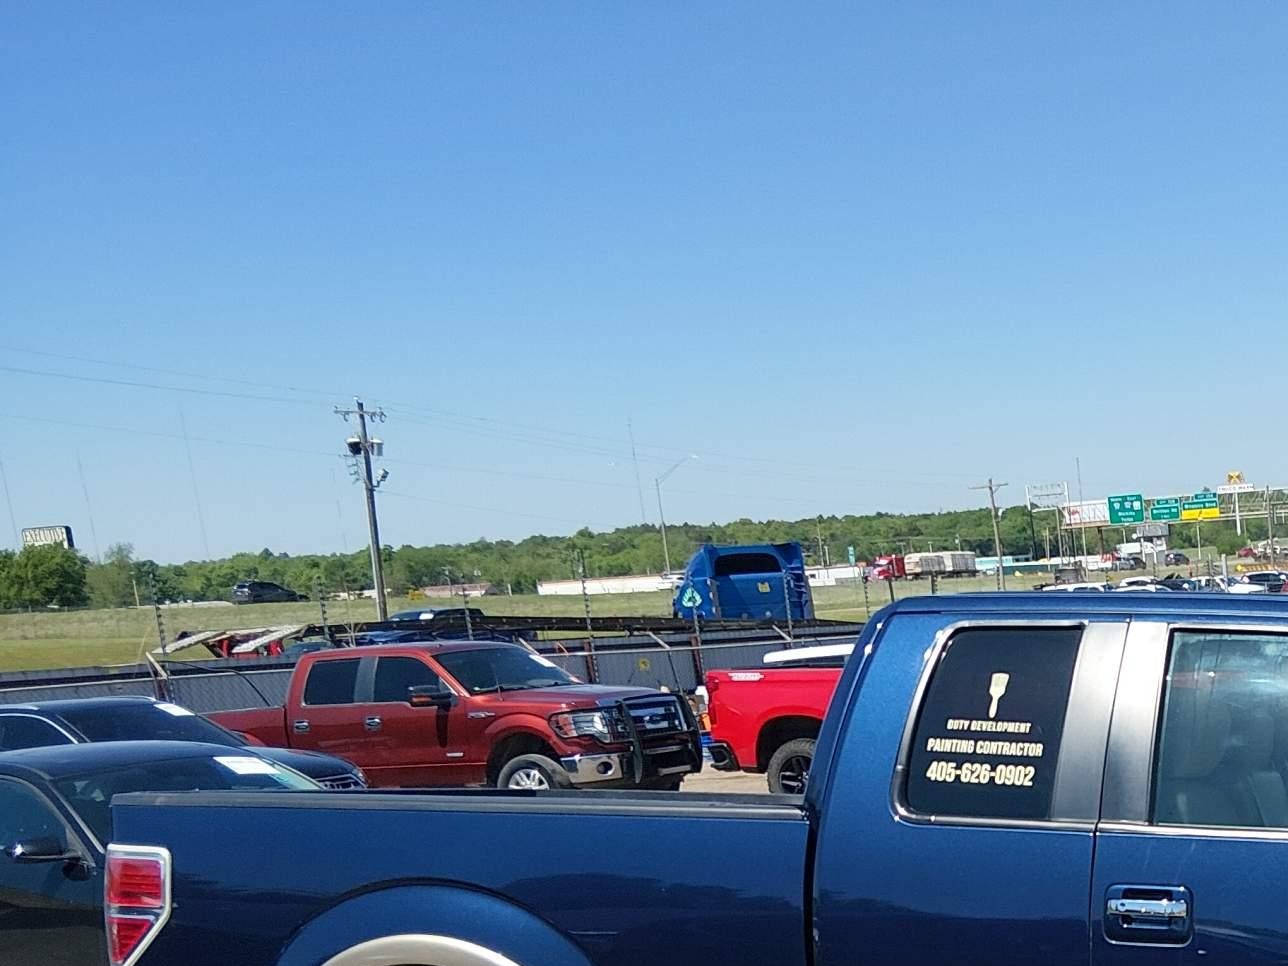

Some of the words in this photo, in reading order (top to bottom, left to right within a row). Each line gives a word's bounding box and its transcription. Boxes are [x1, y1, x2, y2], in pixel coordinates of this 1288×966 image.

[970, 720, 1031, 734] DEVELOPMENT
[927, 738, 974, 754] PAINTING
[975, 739, 1043, 757] CONTRACTOR
[926, 760, 1035, 786] 405-626-0902
